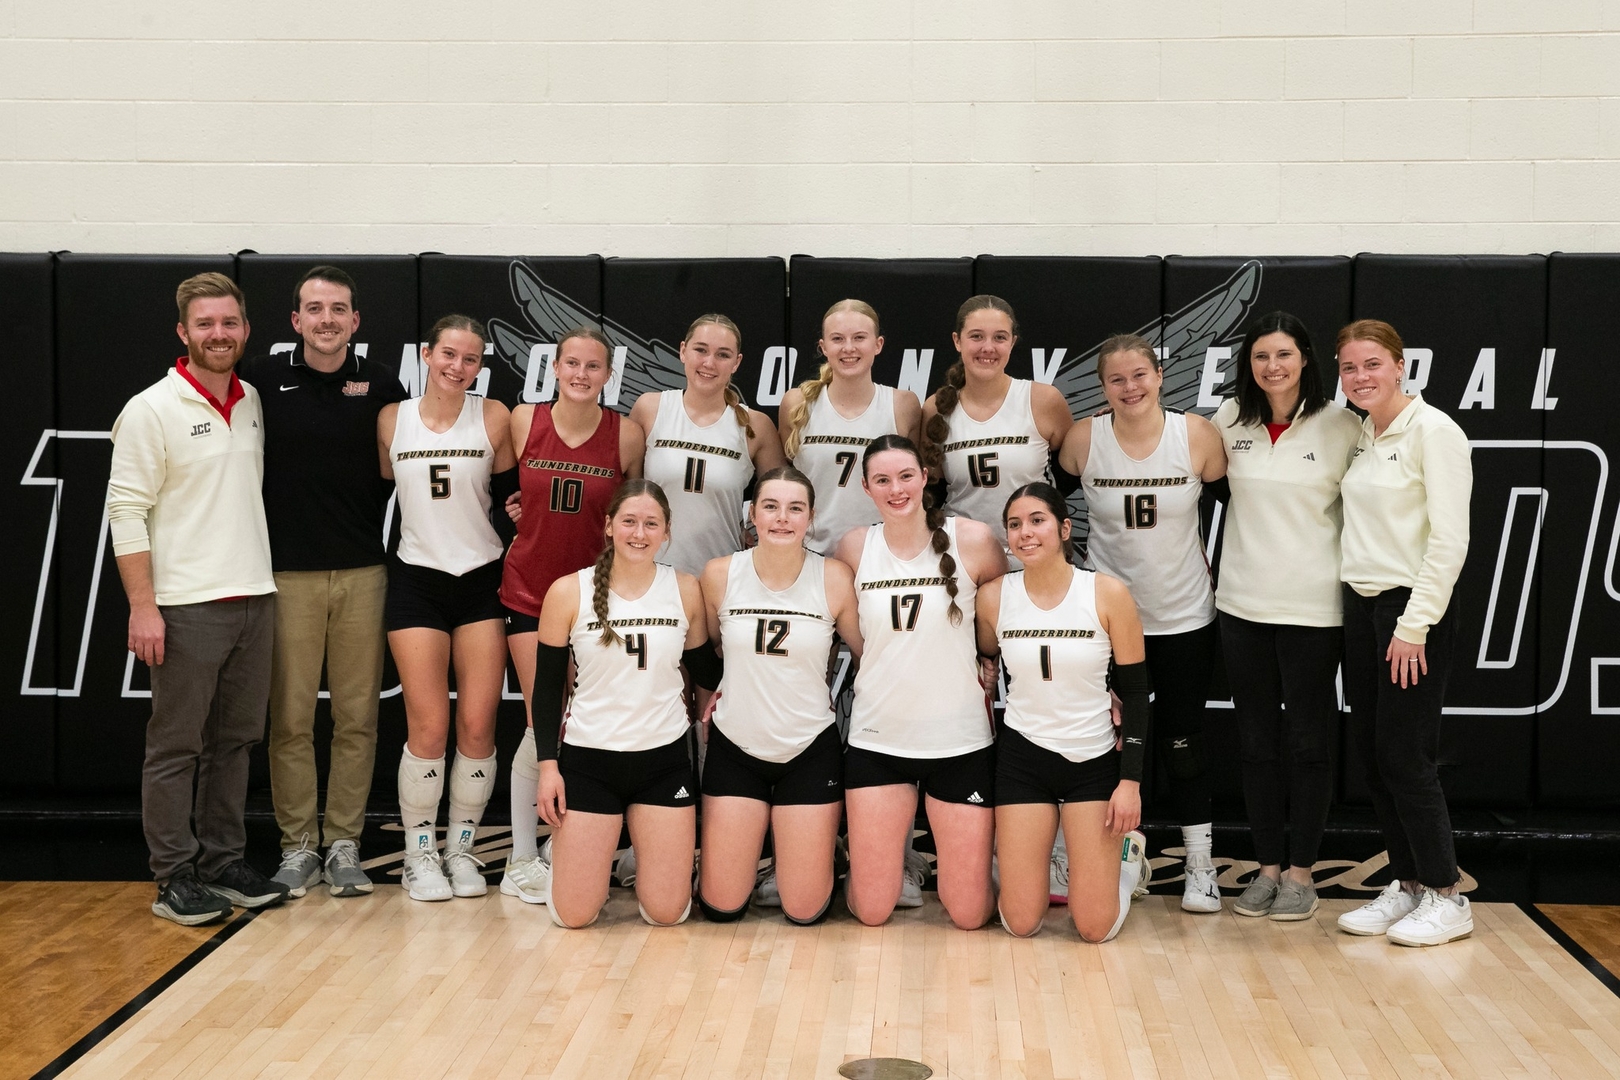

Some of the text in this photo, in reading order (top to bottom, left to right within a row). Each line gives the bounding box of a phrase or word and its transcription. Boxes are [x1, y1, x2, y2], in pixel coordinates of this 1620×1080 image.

[190, 421, 211, 437] JCC
[1231, 439, 1254, 451] JCC
[396, 449, 486, 462] THUNDERBIRDS
[526, 459, 615, 478] THUNDERBIRDS
[653, 439, 743, 461] THUNDERBIRDS
[428, 463, 452, 501] 5
[683, 456, 707, 494] 11
[835, 451, 858, 488] 7
[967, 451, 1001, 489] 15
[1092, 476, 1189, 488] THUNDERBIRDS
[550, 476, 584, 514] 10
[1124, 493, 1158, 530] 16
[586, 618, 680, 632] THNDERBIRDS
[890, 593, 924, 632] 17
[624, 633, 648, 671] 4
[755, 618, 791, 656] 12
[1002, 629, 1096, 640] THUNDERBIRDS
[1040, 644, 1053, 682] 1
